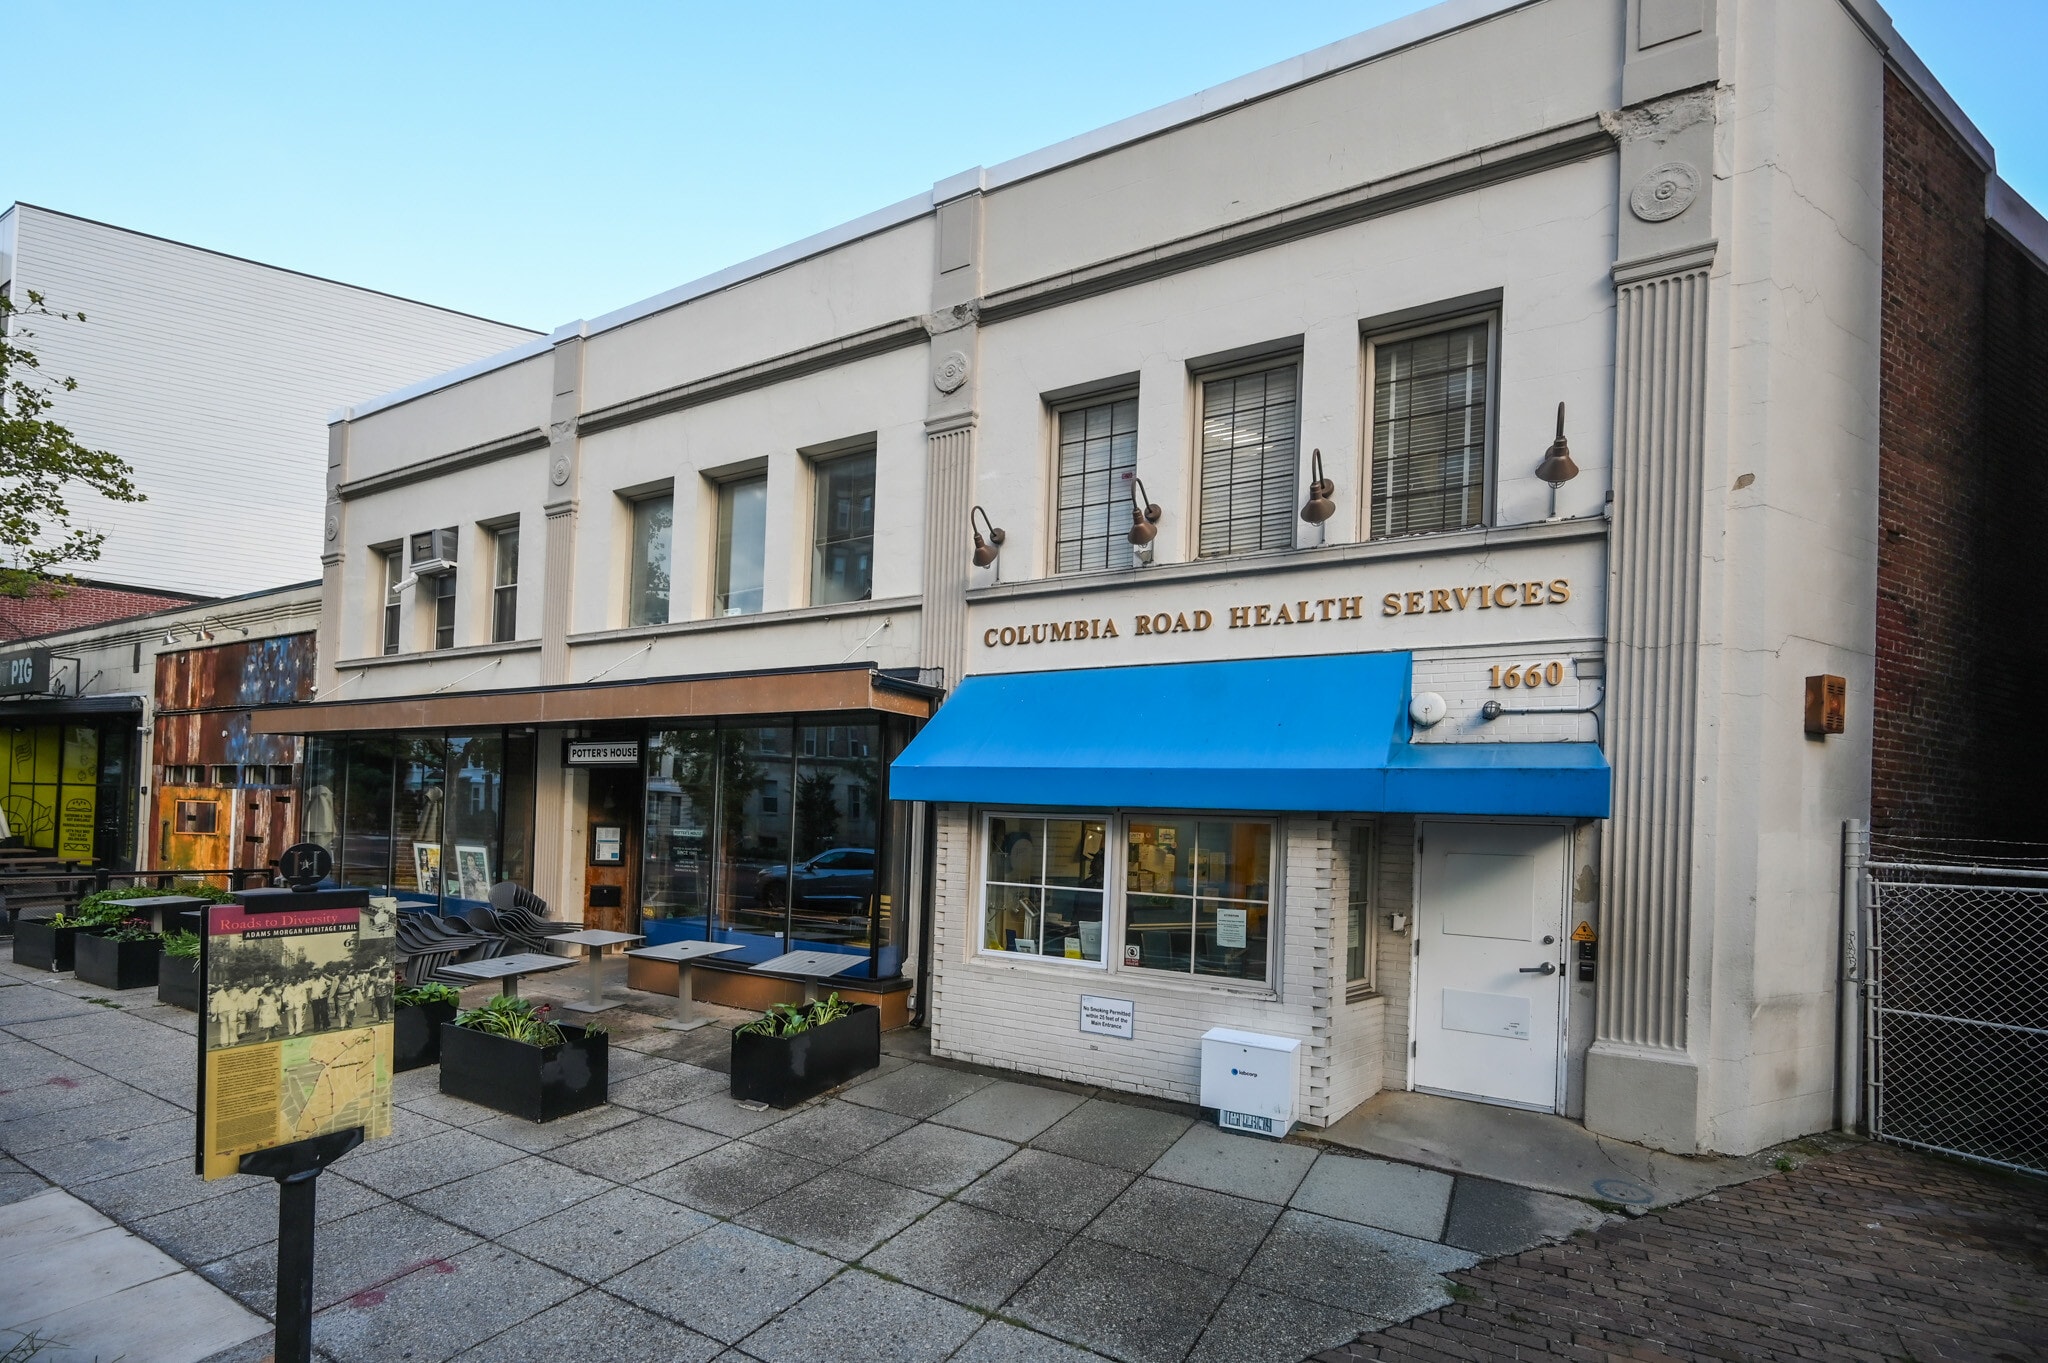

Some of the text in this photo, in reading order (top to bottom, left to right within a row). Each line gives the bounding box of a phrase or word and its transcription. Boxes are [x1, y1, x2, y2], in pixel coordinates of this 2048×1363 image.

[984, 578, 1571, 648] COLUMBIA ROAD HEALTH SERVICES
[11, 657, 33, 685] PIG
[1488, 660, 1564, 689] 1660
[572, 747, 637, 758] POTTER'S HOUSE
[220, 912, 338, 930] Roads to Diversity
[245, 929, 271, 938] ADAMS
[273, 927, 303, 936] MORGAN
[305, 925, 337, 934] HERITAGE
[1090, 1006, 1108, 1014] Smoking
[1110, 1009, 1131, 1017] Permitted
[1102, 1021, 1122, 1029] Entrance
[1239, 1070, 1258, 1078] labcorp
